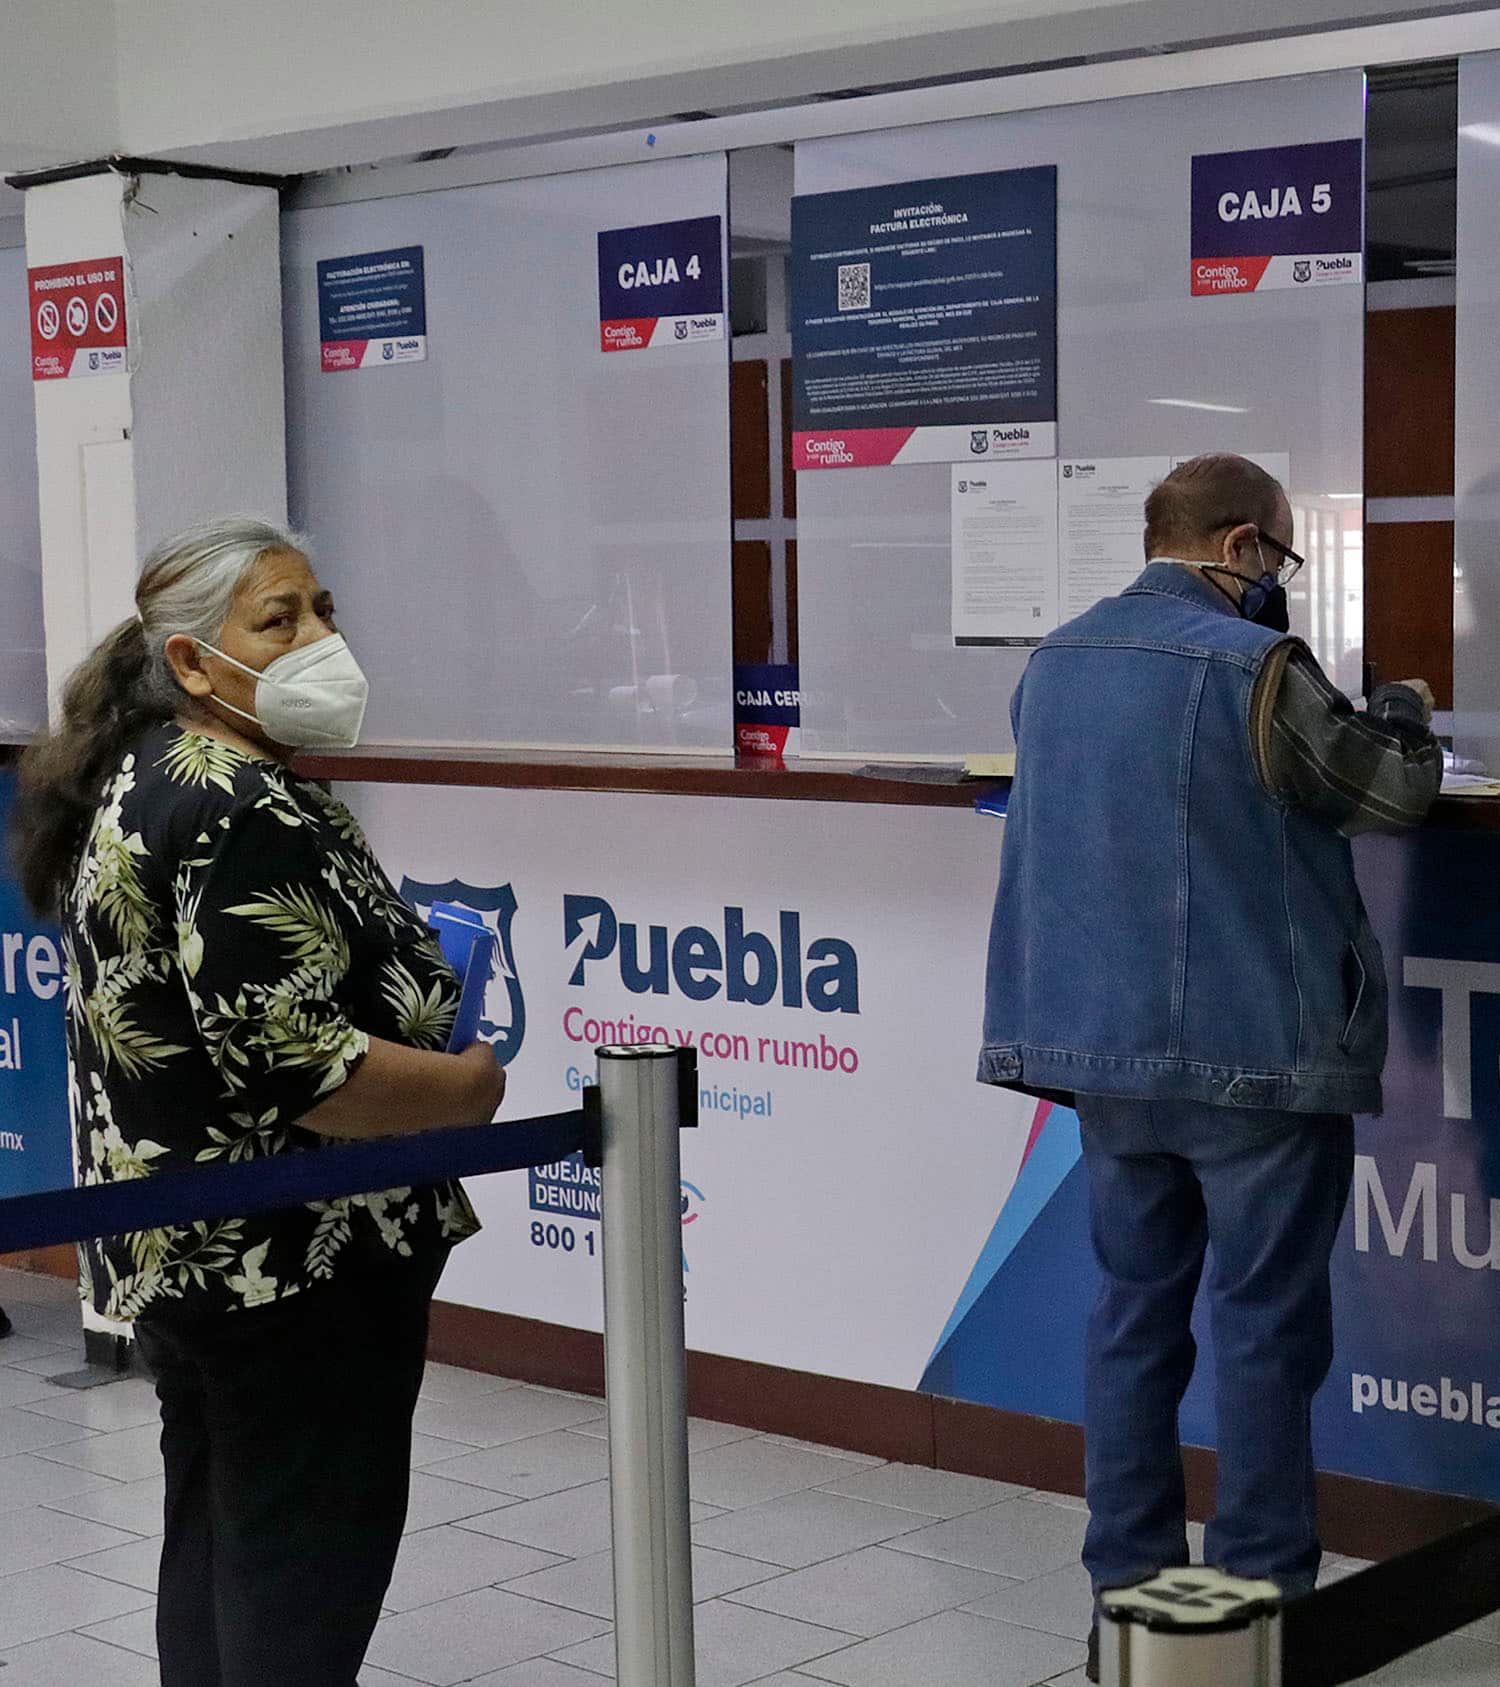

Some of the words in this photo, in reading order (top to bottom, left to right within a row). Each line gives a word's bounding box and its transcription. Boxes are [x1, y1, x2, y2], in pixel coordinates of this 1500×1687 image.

[1218, 186, 1302, 222] CAJA
[1311, 183, 1332, 214] 5
[870, 221, 908, 235] FACTURA
[909, 213, 968, 229] ELECTRÓNICA
[618, 258, 680, 289] CAJA
[686, 255, 701, 280] 4
[1197, 264, 1239, 280] Contigo
[1316, 258, 1352, 271] Puebla
[1212, 275, 1248, 290] rumbo
[993, 428, 1030, 441] Puebla
[806, 438, 846, 454] Contigo
[821, 450, 854, 465] rumbo
[736, 690, 772, 706] CAJA
[562, 894, 861, 1014] Puebla
[563, 1006, 670, 1045] Contigo
[675, 1028, 693, 1046] y
[700, 1031, 749, 1061] con
[758, 1032, 859, 1074] rumbo
[701, 1085, 772, 1119] nicipal
[535, 1183, 601, 1214] DENUN
[530, 1220, 576, 1252] 800
[584, 1230, 595, 1256] 1
